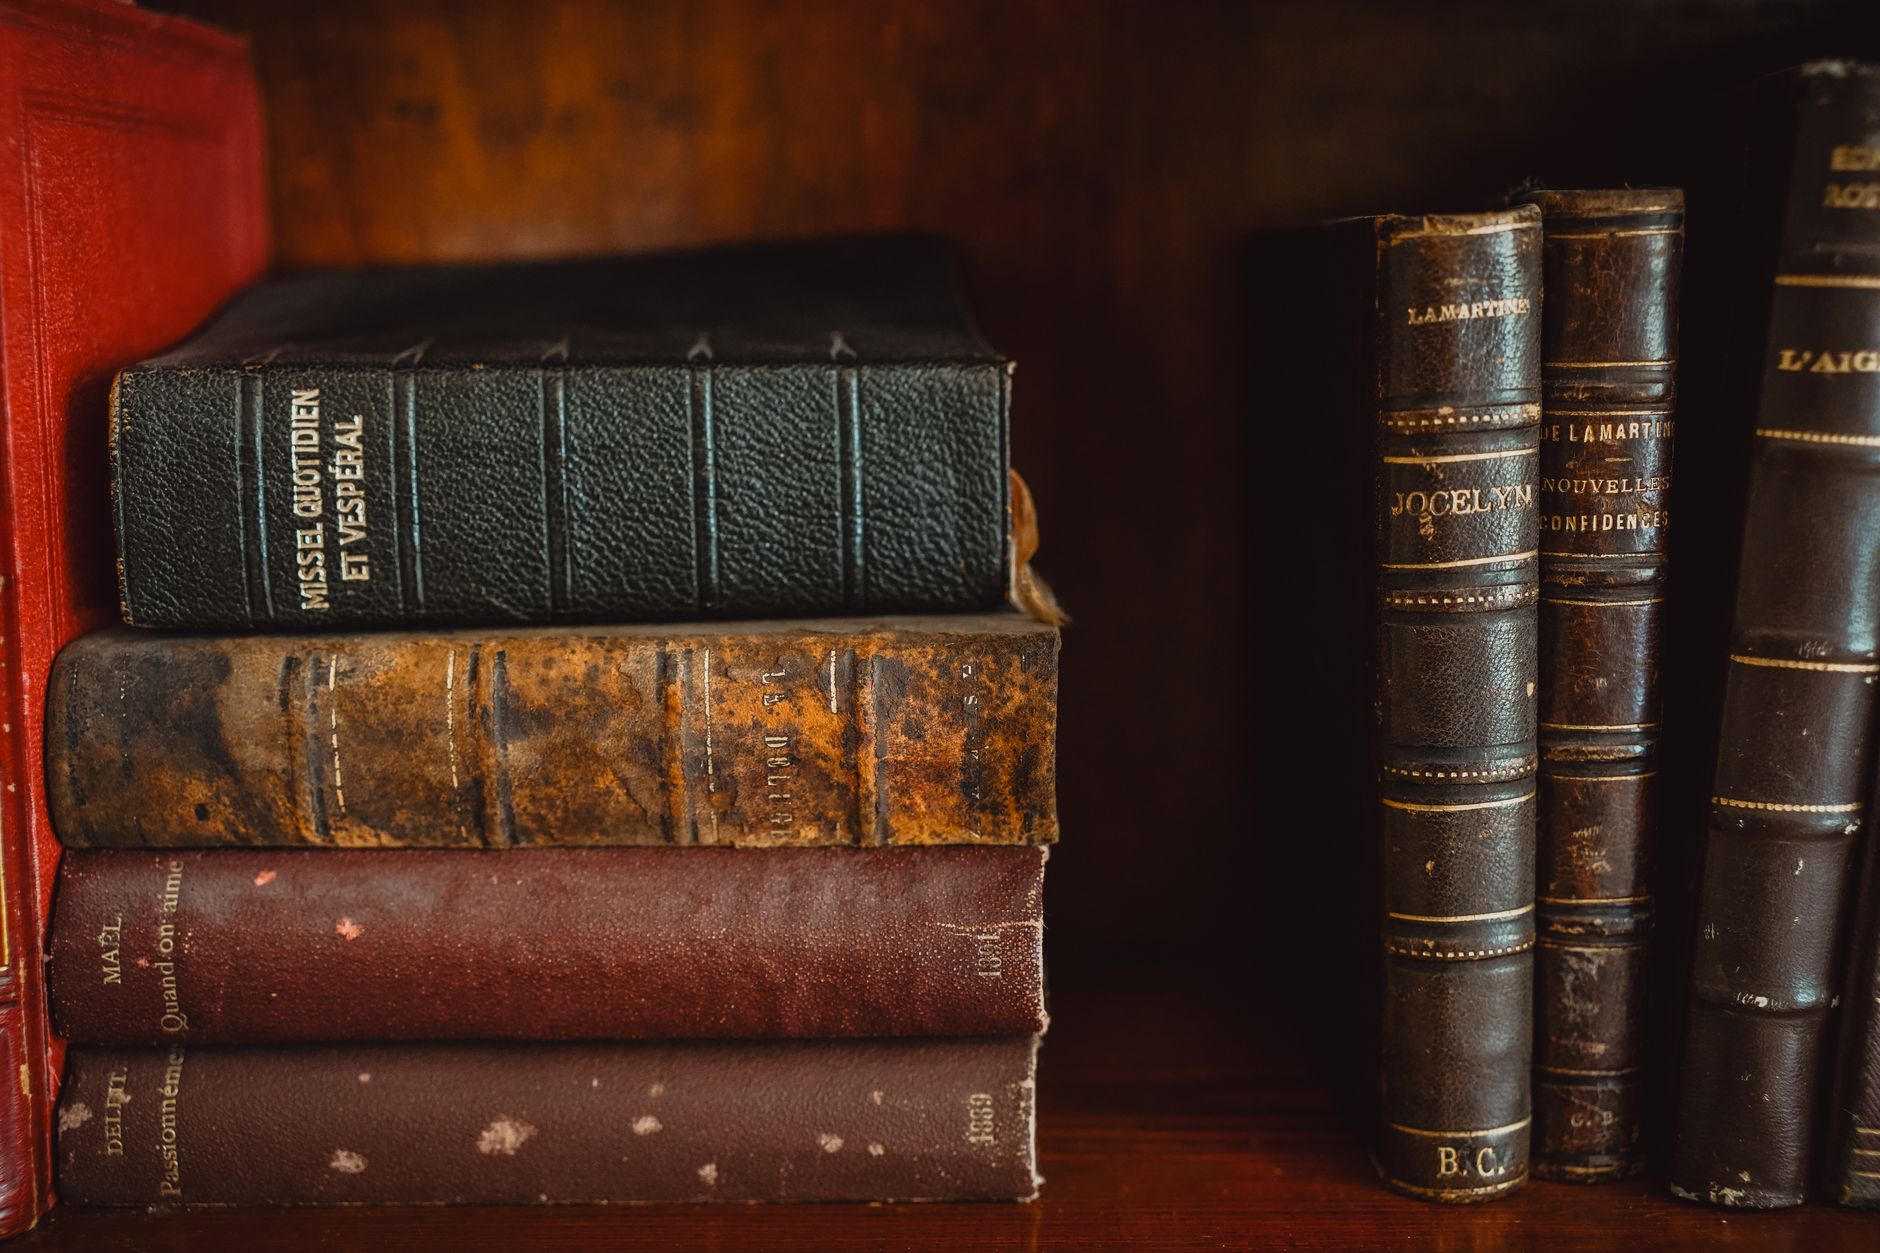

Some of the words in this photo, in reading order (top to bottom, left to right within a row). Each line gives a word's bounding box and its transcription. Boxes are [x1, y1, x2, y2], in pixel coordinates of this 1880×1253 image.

[1407, 297, 1530, 325] LAMARTINE
[1777, 349, 1880, 373] L'AIG
[291, 388, 323, 518] QUOTIDIEN
[328, 414, 367, 546] VESPÉRAL
[1542, 476, 1671, 494] NOUVELLES
[1391, 484, 1533, 517] JOCELYN
[1540, 511, 1670, 532] CONFIDENCES
[297, 522, 330, 610] MISSEL
[341, 551, 370, 581] ET
[157, 861, 184, 913] aime
[159, 924, 175, 954] on
[977, 935, 1001, 978] 1891
[154, 962, 189, 1032] Quand
[1436, 1147, 1468, 1178] B.
[1476, 1147, 1506, 1177] C.
